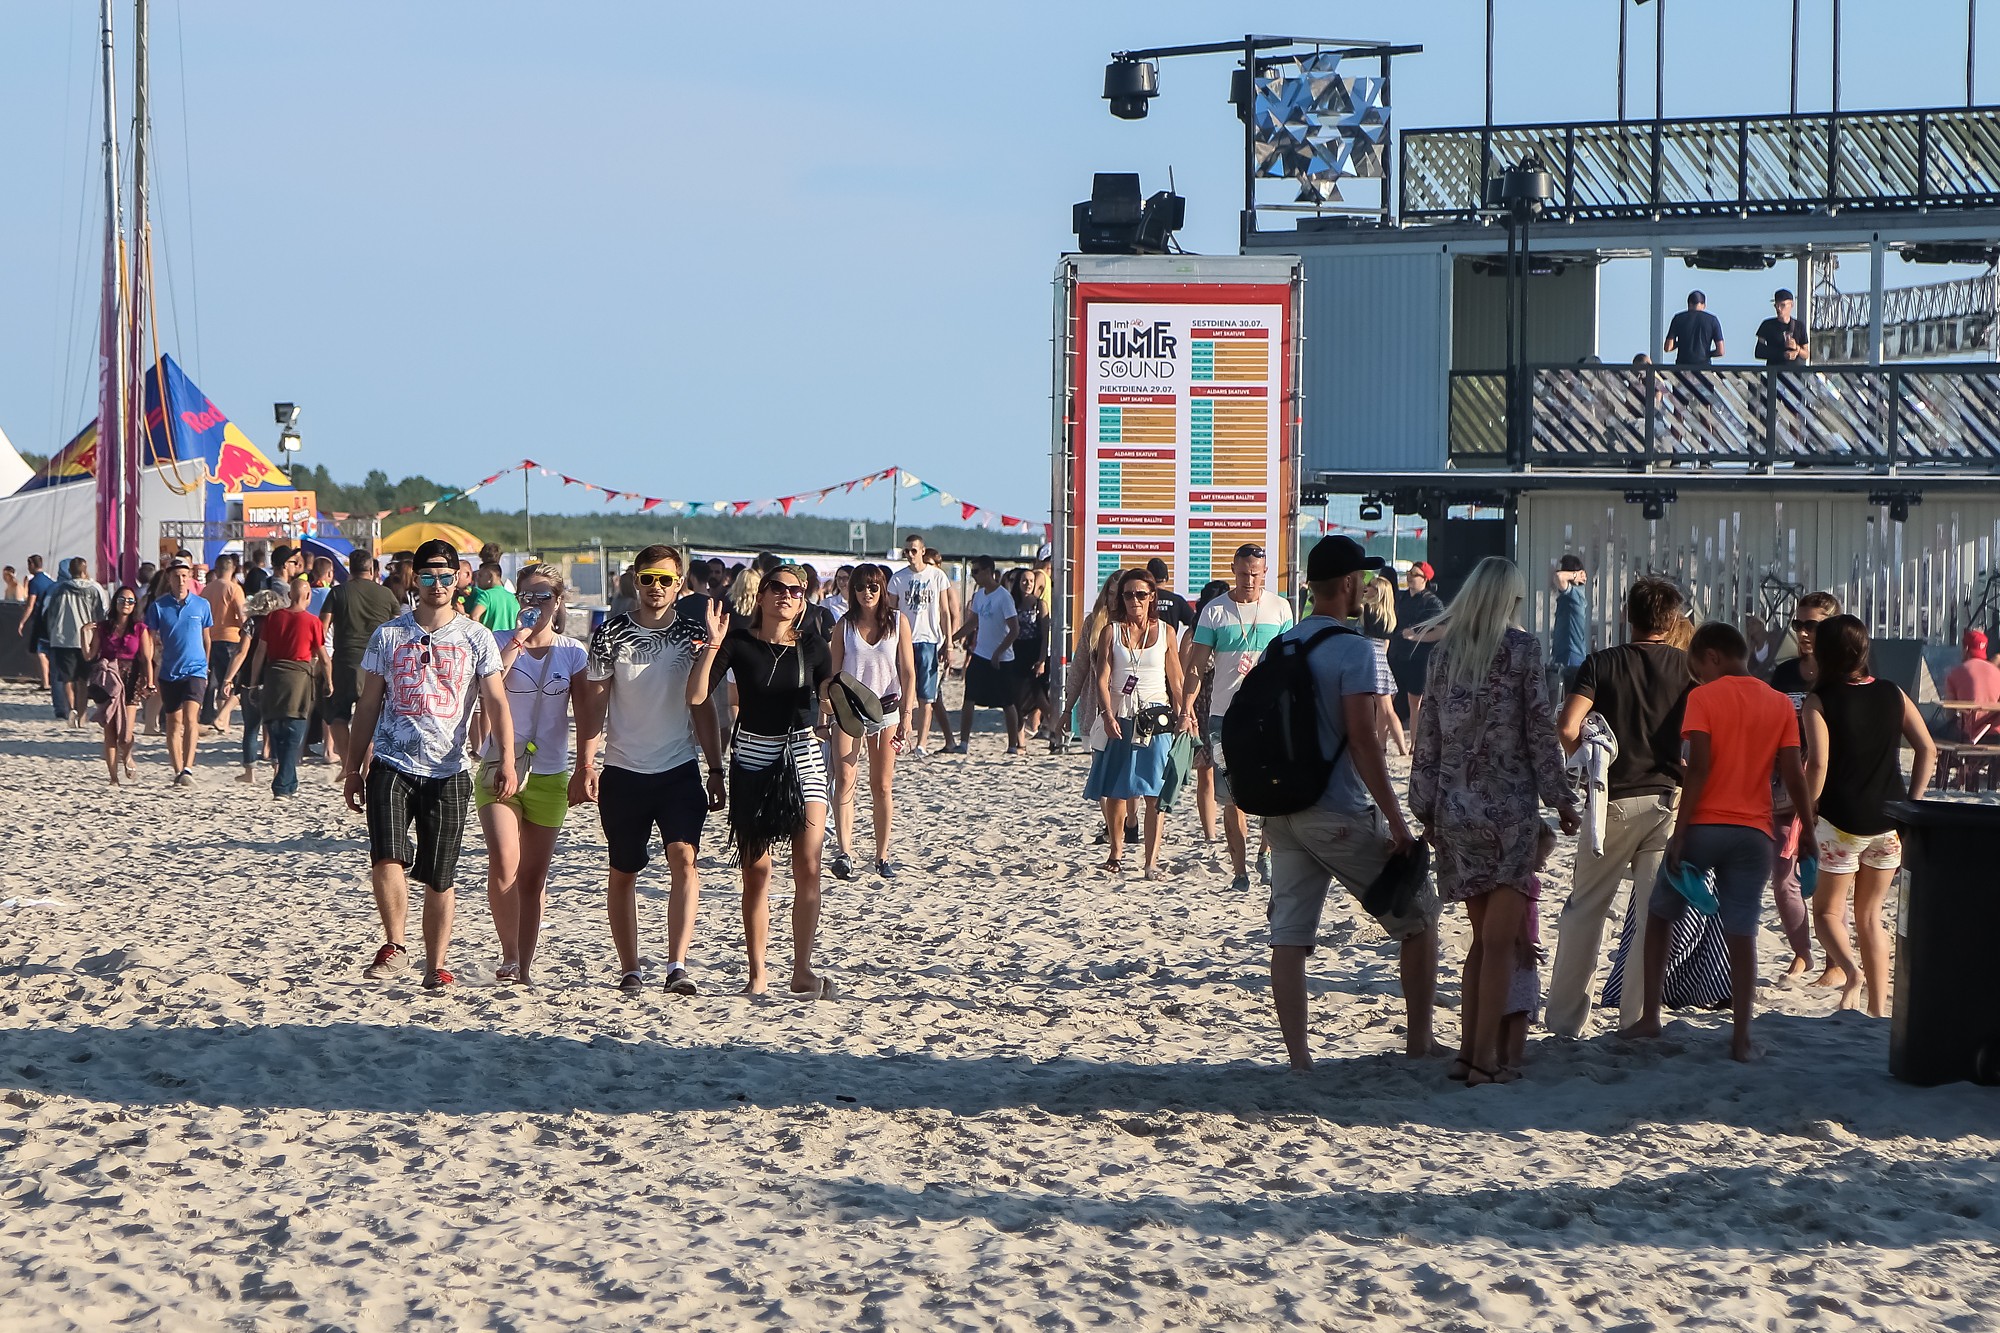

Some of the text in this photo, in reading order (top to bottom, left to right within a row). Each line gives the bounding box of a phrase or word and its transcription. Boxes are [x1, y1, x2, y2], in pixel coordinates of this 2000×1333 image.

[1099, 360, 1175, 378] SOUND
[1099, 385, 1175, 394] PIEKTDIENA 29.07.
[181, 398, 226, 434] Red
[854, 525, 862, 536] 4
